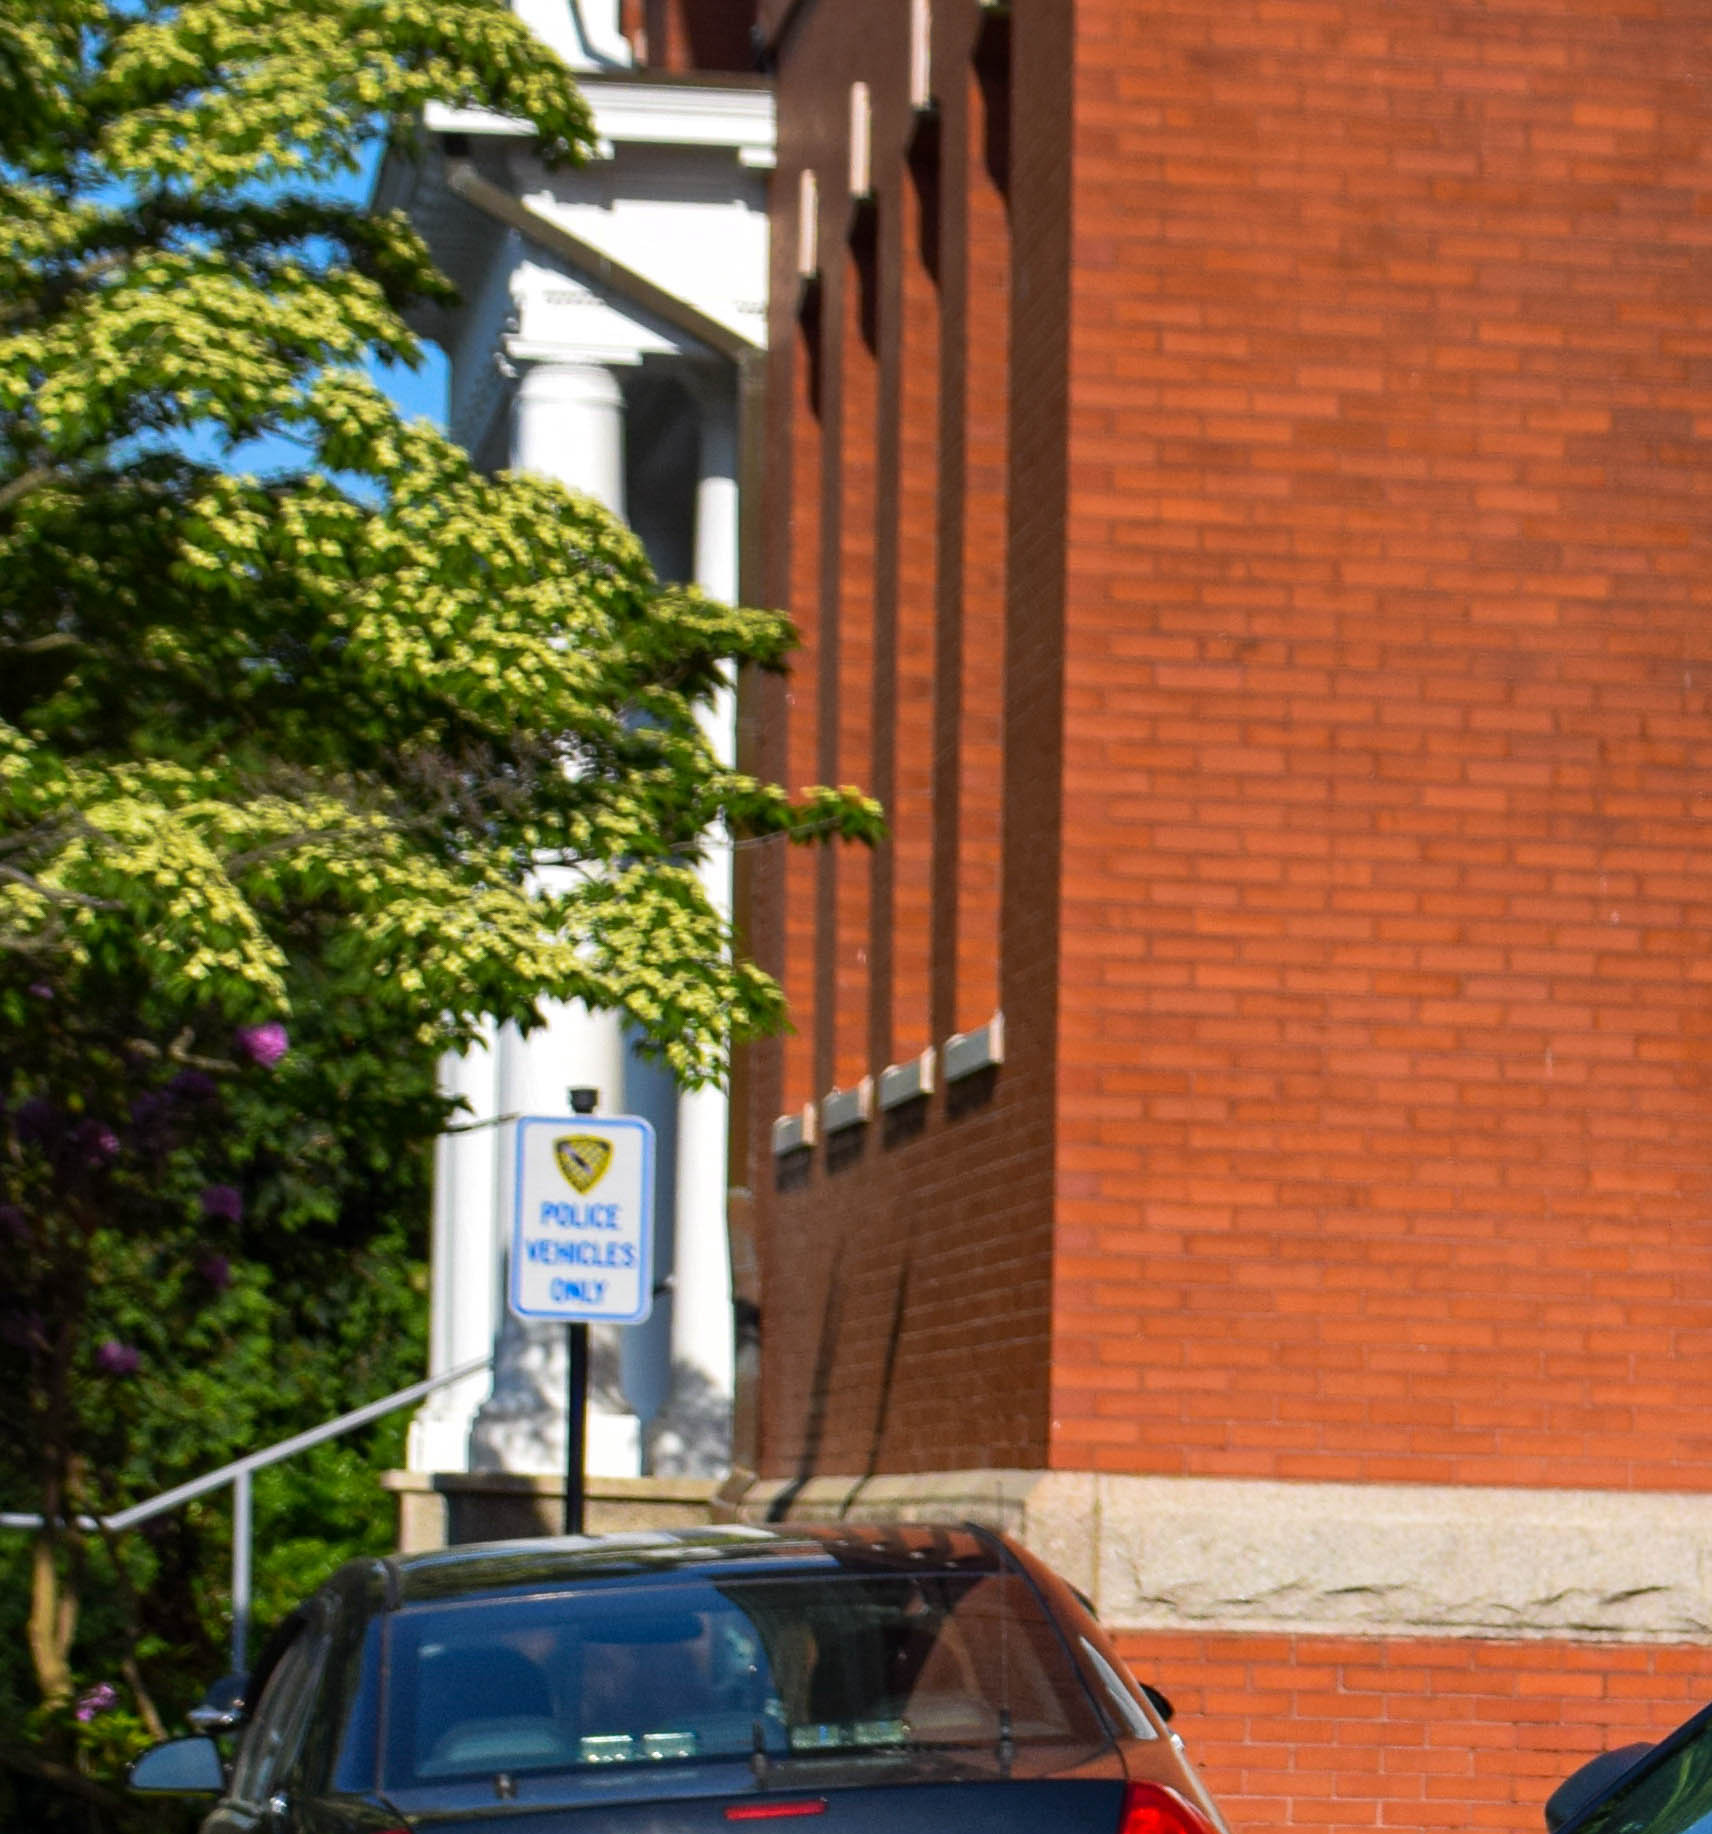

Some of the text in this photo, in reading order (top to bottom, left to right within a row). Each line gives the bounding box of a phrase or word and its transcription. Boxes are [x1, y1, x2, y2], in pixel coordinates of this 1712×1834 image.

[540, 1201, 620, 1229] POLICE
[526, 1240, 635, 1268] VEHICLES
[550, 1278, 605, 1304] ONLY
